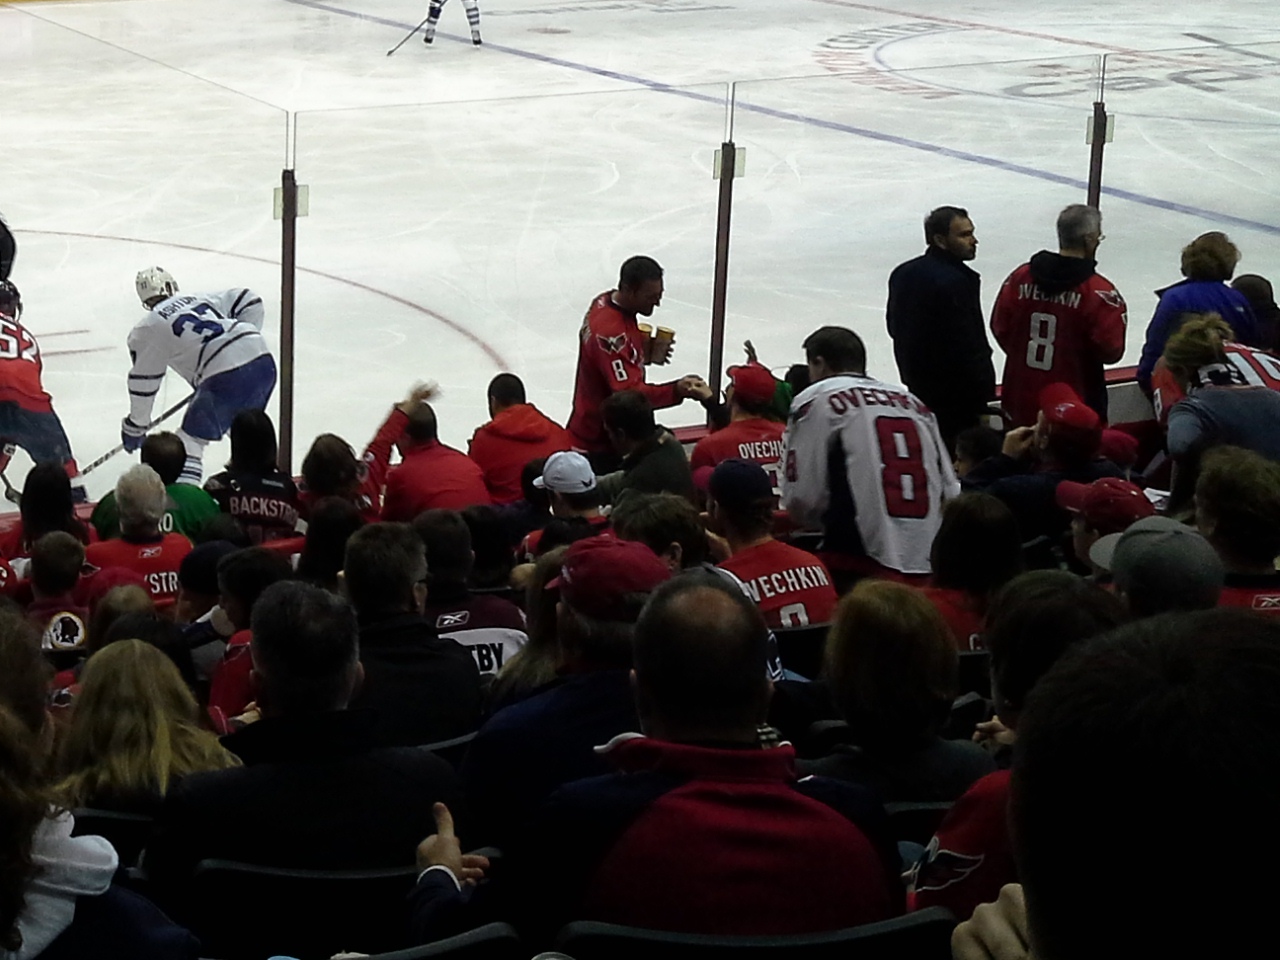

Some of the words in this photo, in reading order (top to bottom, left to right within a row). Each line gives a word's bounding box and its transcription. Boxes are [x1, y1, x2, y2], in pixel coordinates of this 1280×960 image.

[1026, 311, 1058, 371] 8
[611, 359, 629, 382] 8
[738, 440, 787, 460] OVECH
[874, 416, 928, 520] 8
[744, 564, 829, 602] VECHKIN
